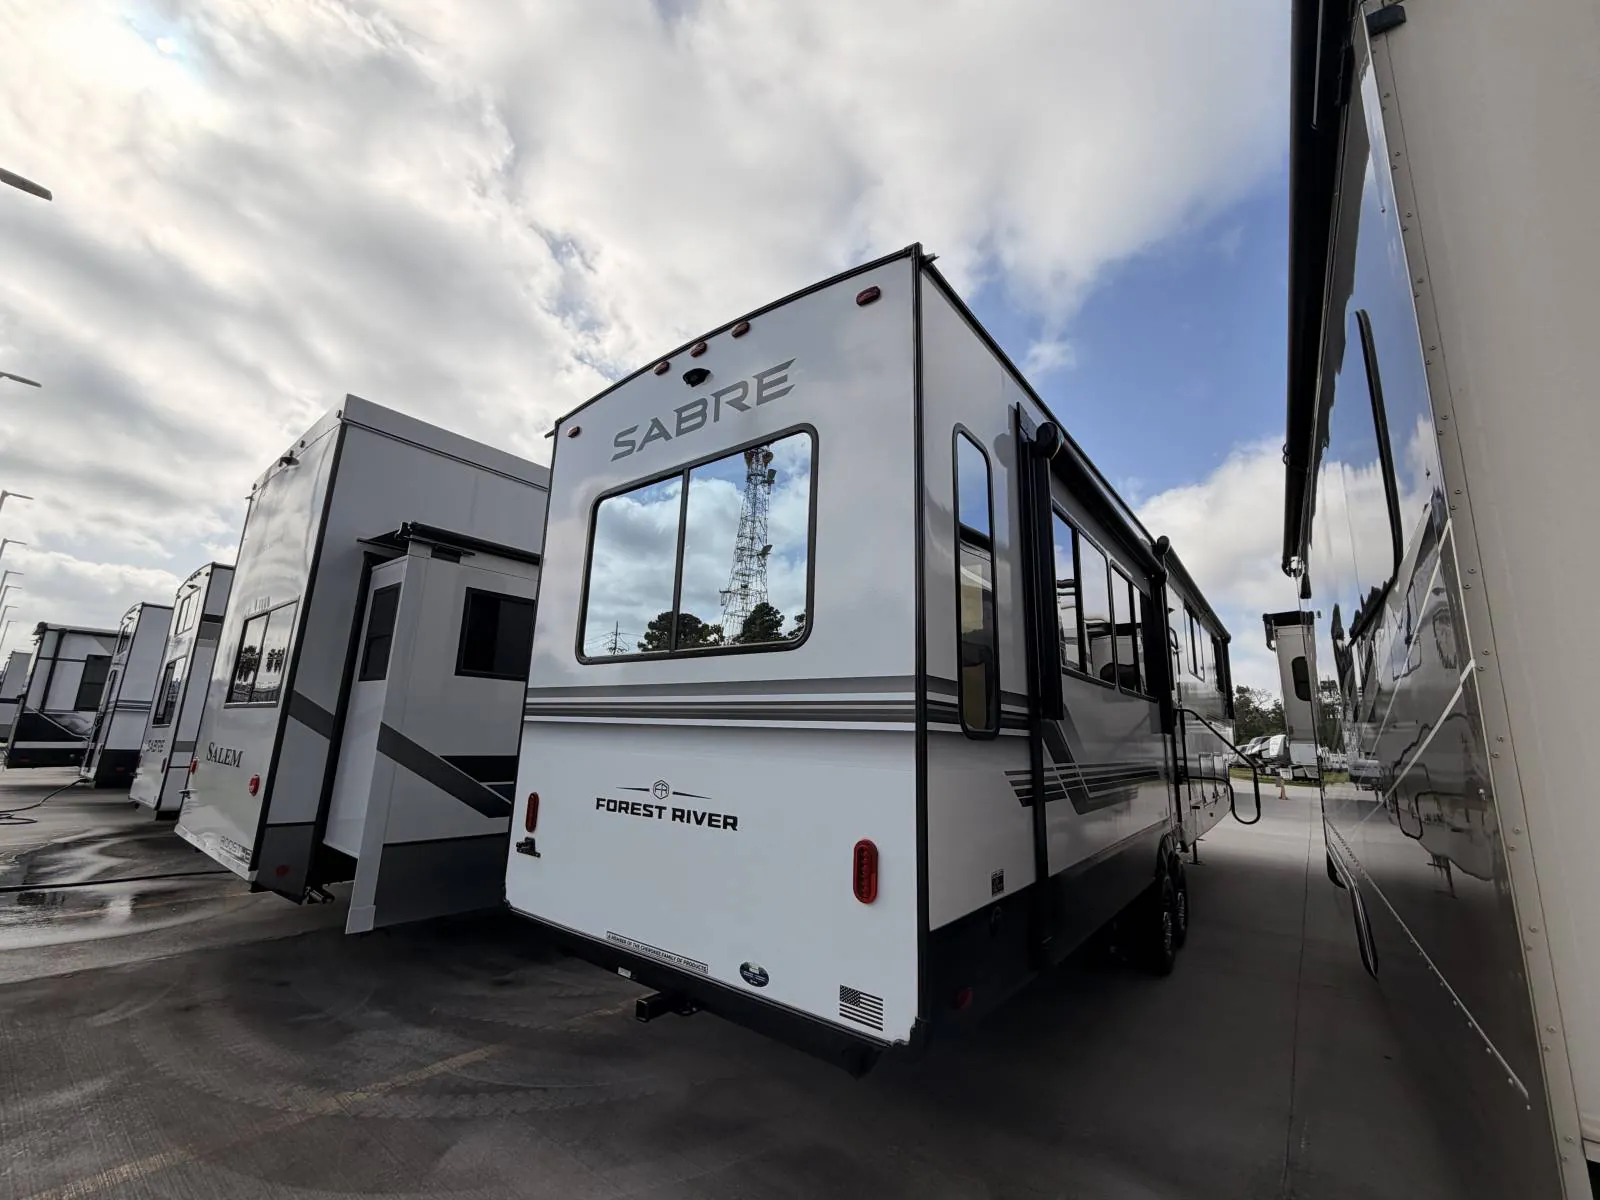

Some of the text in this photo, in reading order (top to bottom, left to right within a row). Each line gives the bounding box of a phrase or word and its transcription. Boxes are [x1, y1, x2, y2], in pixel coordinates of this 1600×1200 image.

[610, 357, 797, 462] SABRE
[206, 742, 244, 768] SALEM
[596, 797, 738, 831] FOREST RIVER
[661, 952, 677, 962] FAMILY
[683, 959, 707, 973] PRODUCTS
